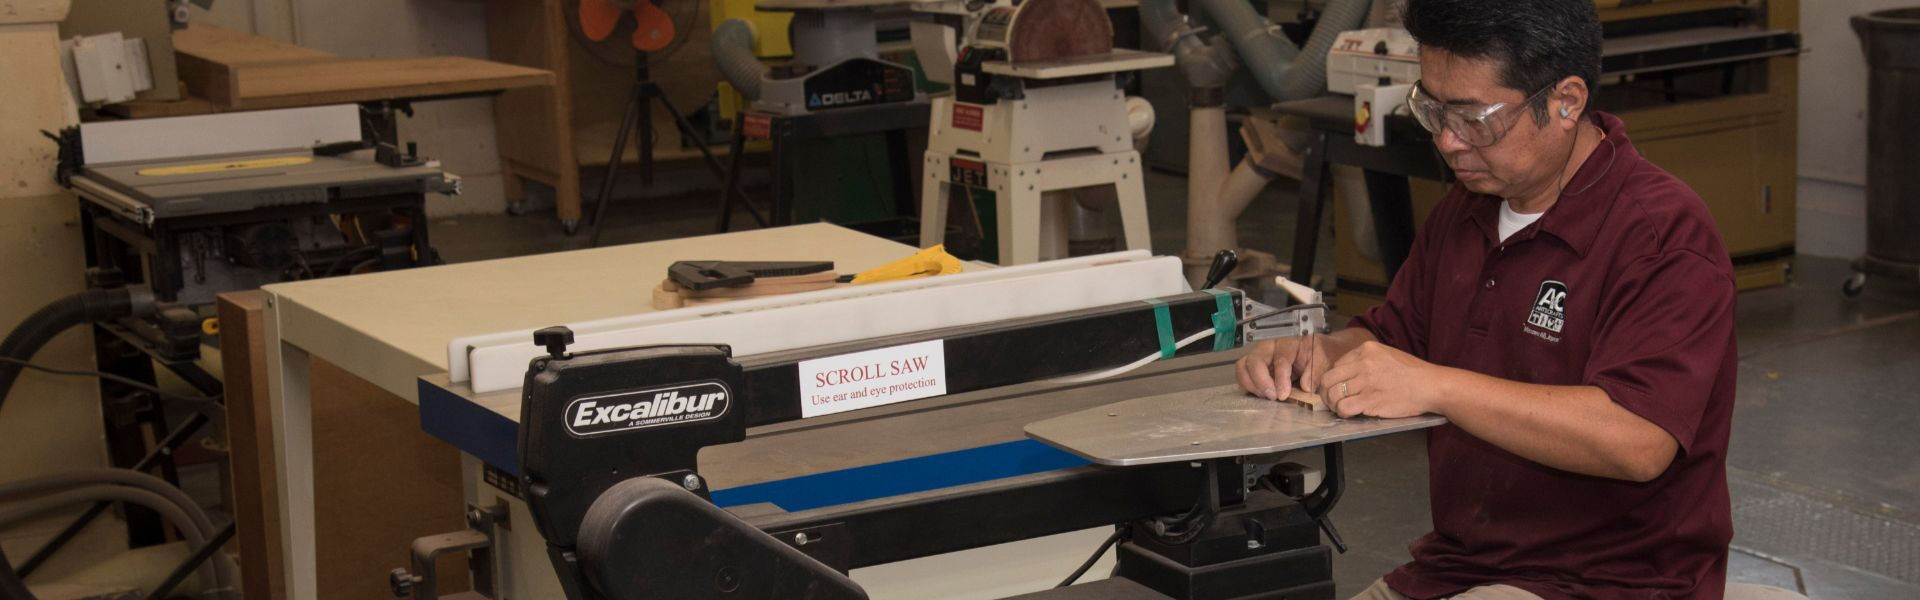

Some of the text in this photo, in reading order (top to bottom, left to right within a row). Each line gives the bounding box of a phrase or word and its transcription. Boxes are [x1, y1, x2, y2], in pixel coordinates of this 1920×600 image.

[821, 90, 872, 105] DELTA
[952, 167, 986, 187] JET
[1538, 288, 1567, 312] AC
[815, 355, 929, 388] SCROLL SAW
[811, 377, 936, 406] Use ear and eye protection
[573, 391, 725, 427] Excalibur
[635, 414, 684, 426] SOMMERVILLE
[685, 411, 711, 420] DESIGN
